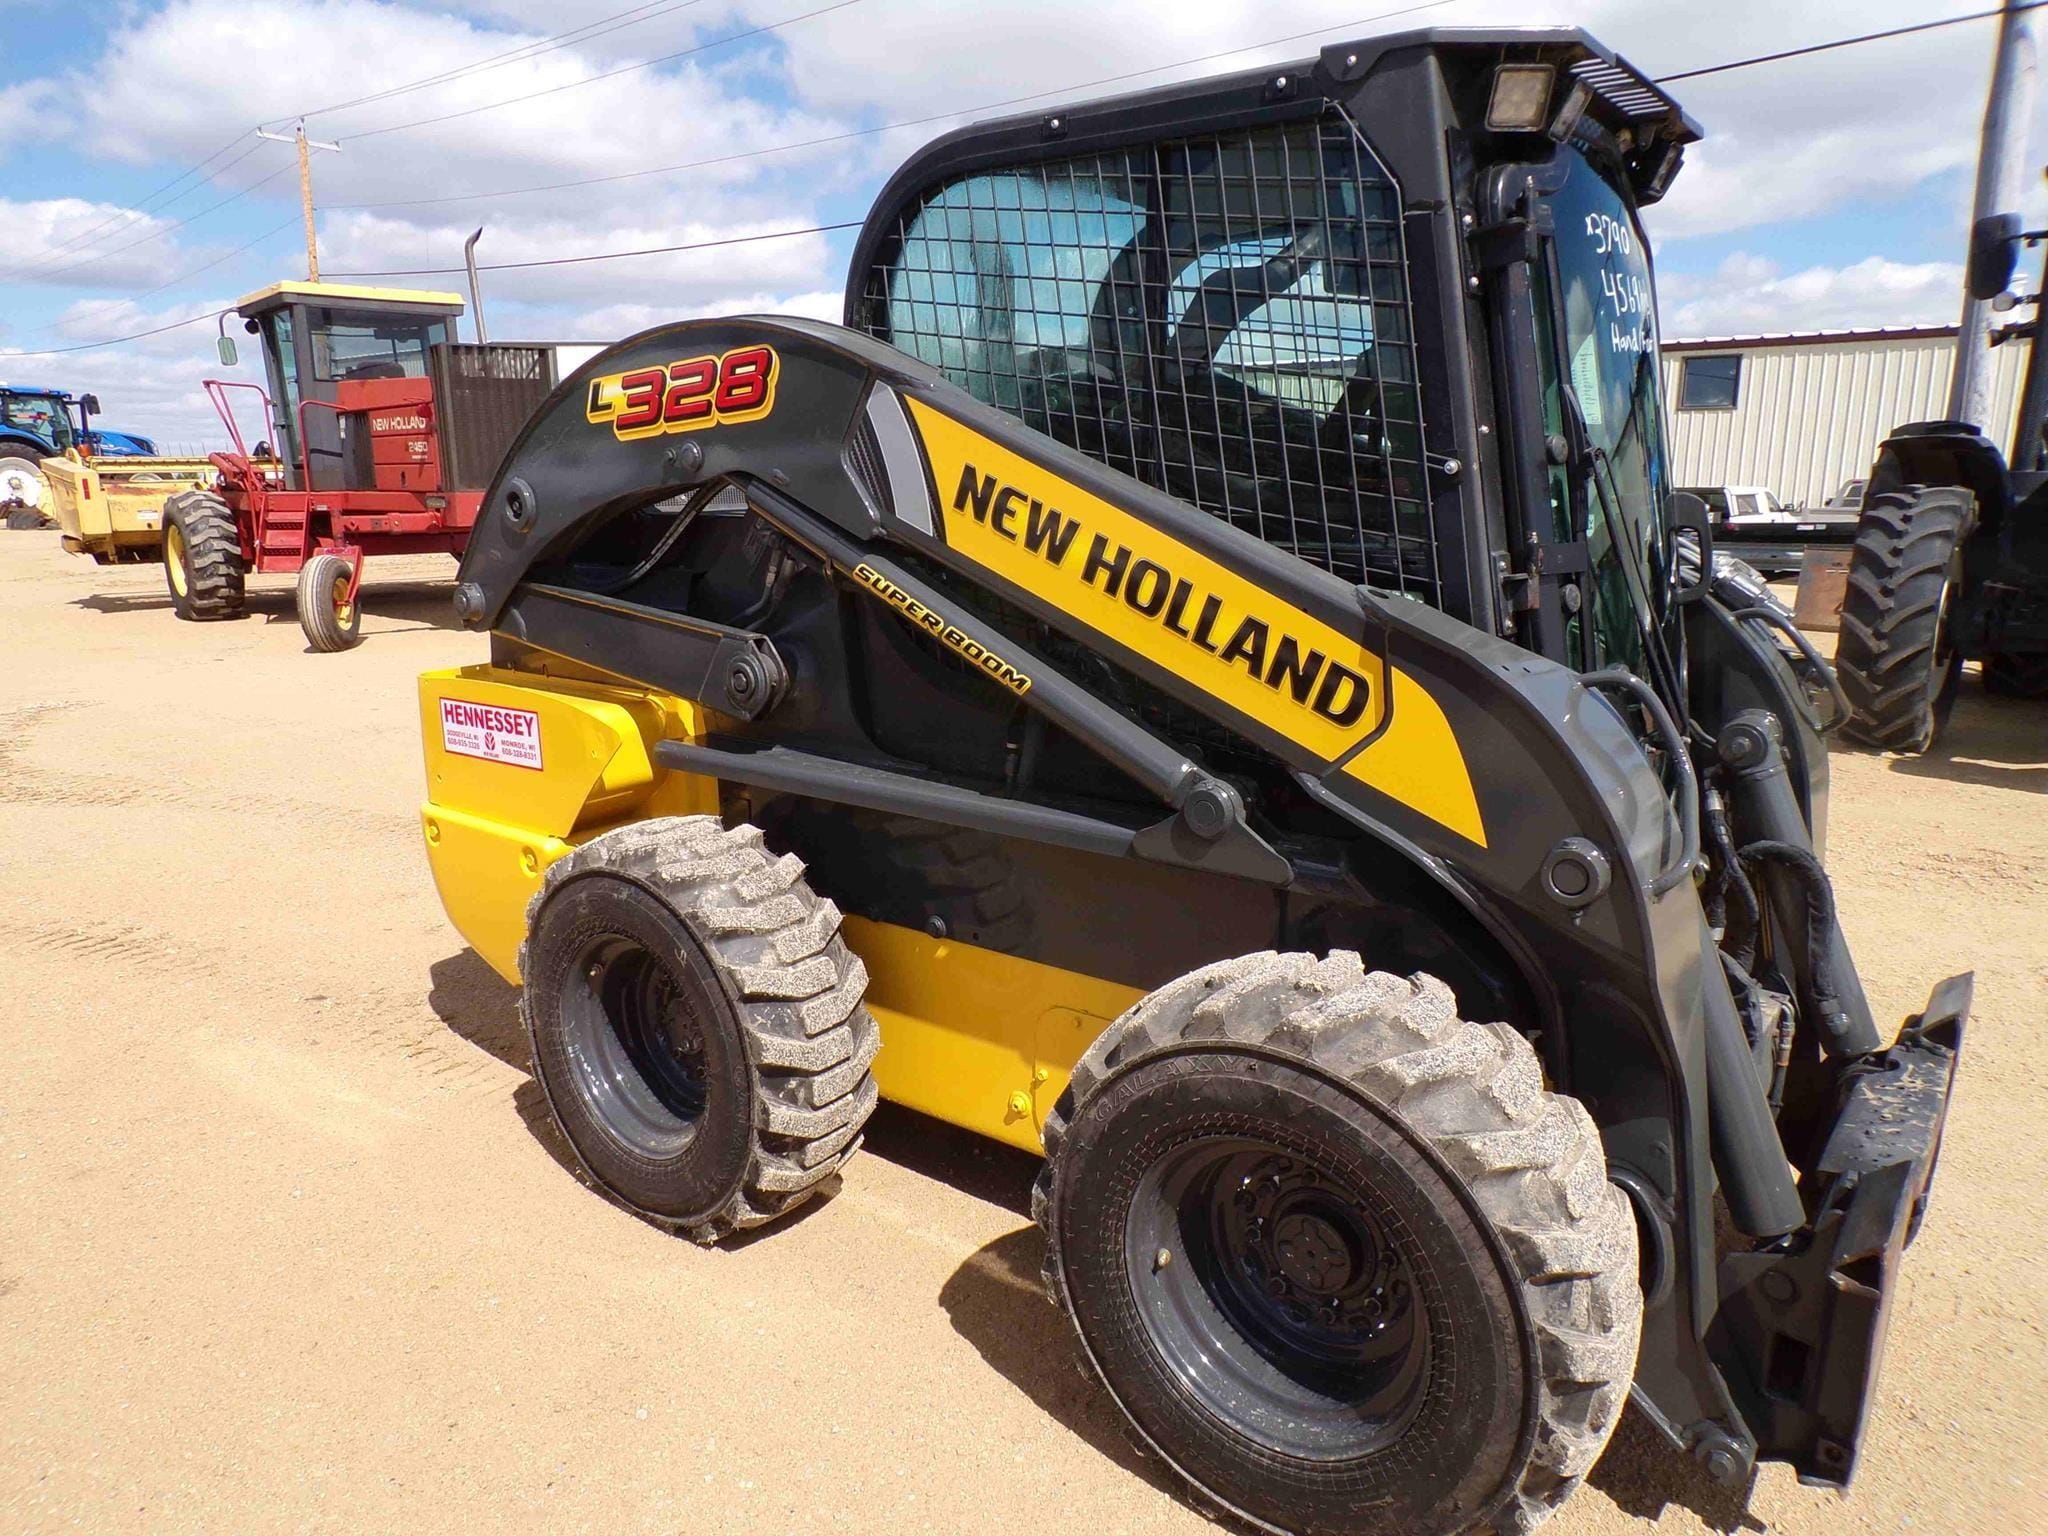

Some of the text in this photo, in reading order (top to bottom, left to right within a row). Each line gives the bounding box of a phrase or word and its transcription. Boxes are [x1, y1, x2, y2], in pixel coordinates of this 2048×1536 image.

[587, 346, 777, 436] L328
[372, 415, 426, 431] NEW HOLLAND
[952, 462, 1371, 729] NEW HOLLAND
[854, 564, 1031, 694] SUPER BOOM
[443, 702, 534, 737] HENNESSEY
[501, 739, 527, 750] MONROE,
